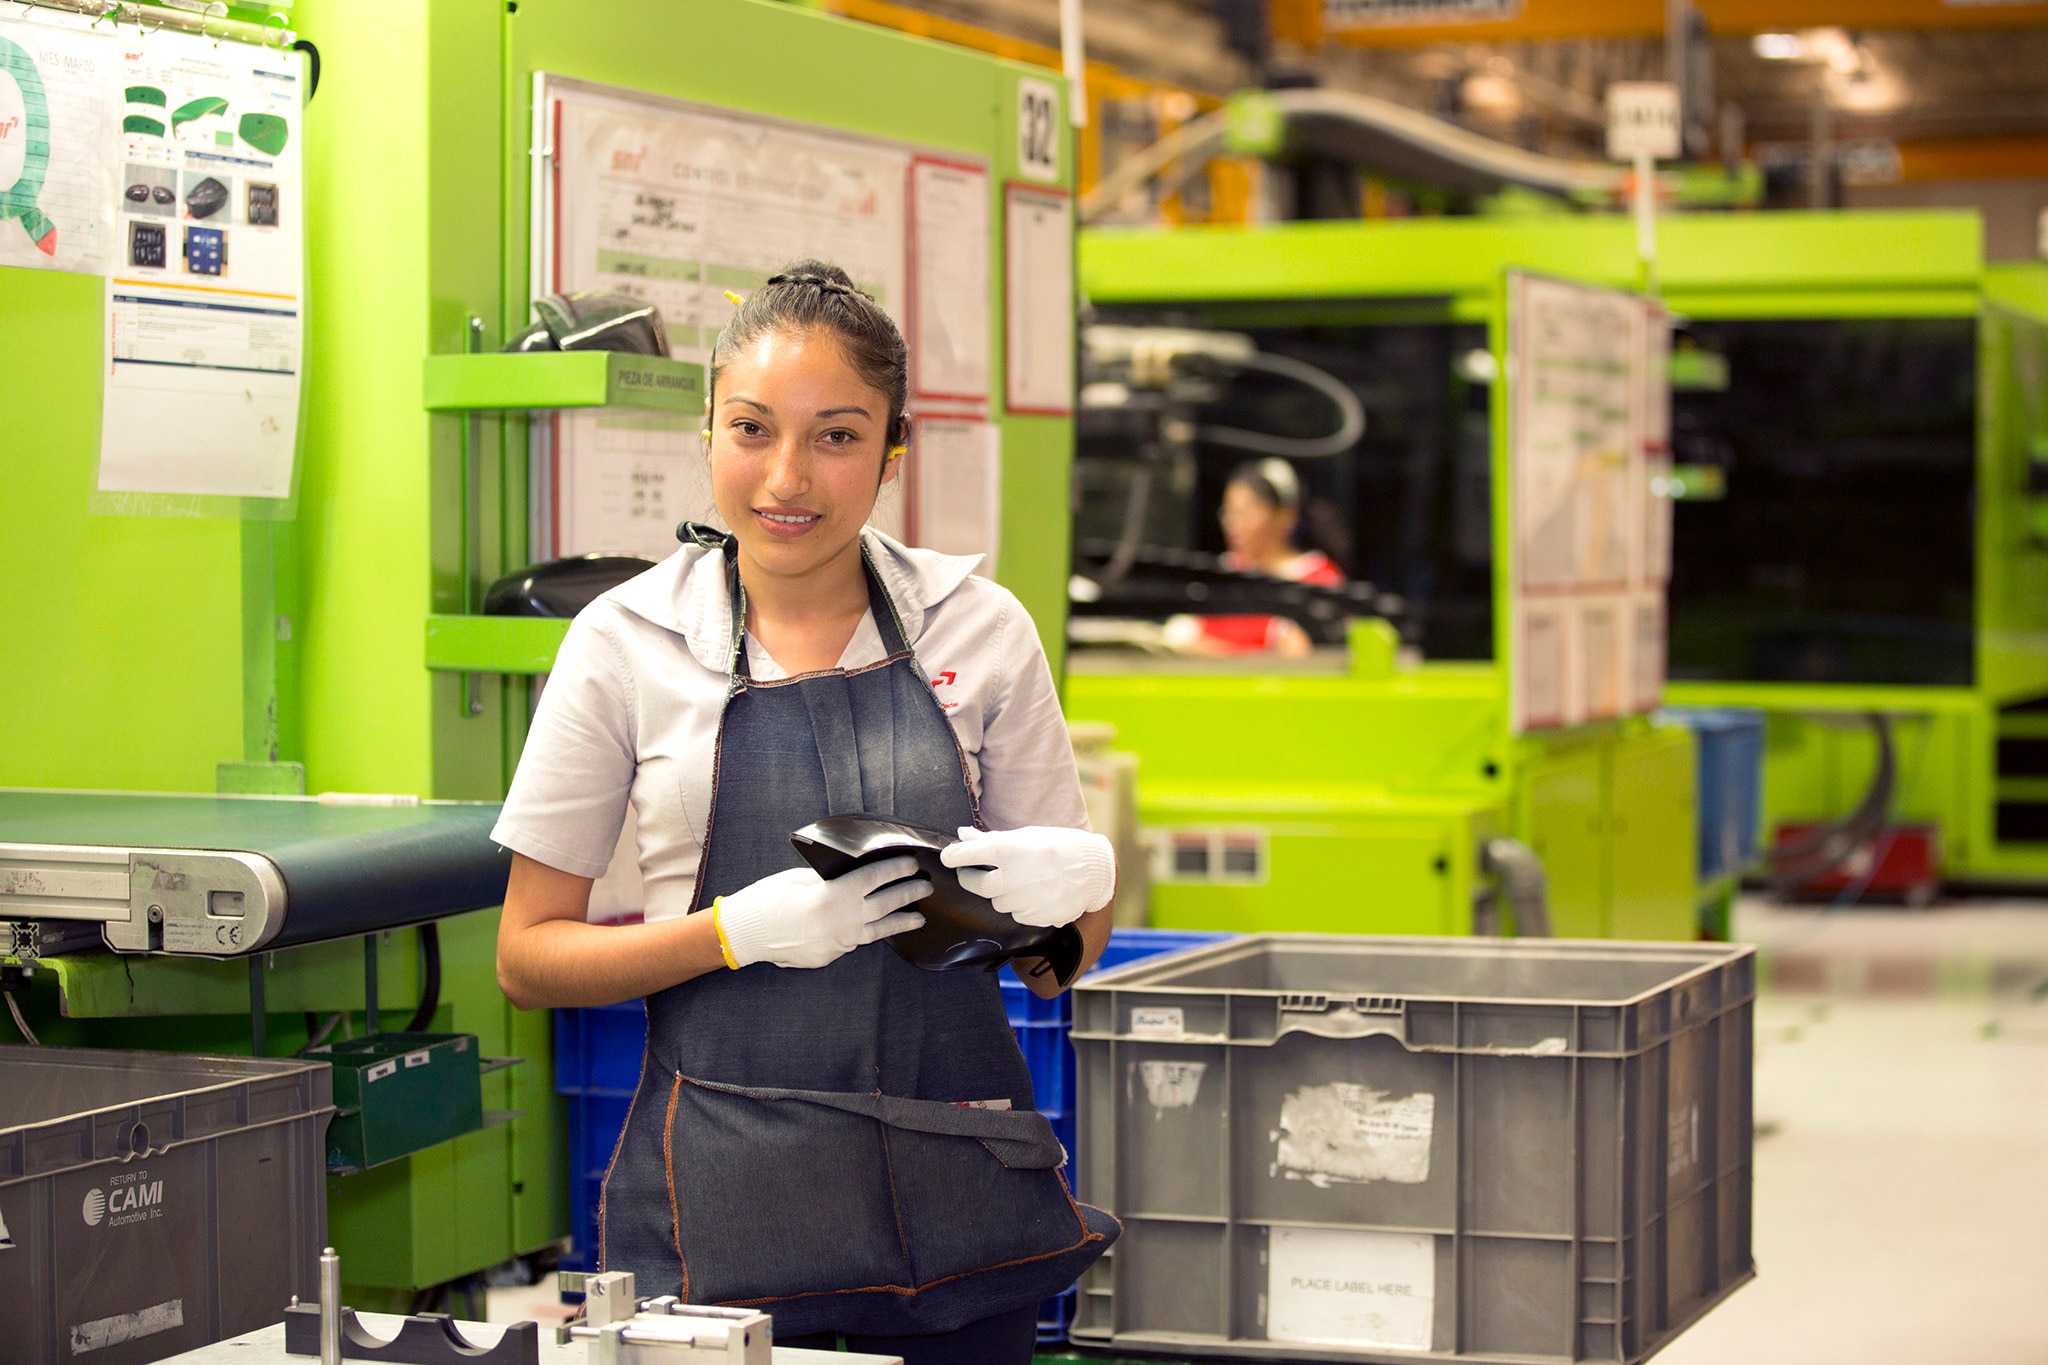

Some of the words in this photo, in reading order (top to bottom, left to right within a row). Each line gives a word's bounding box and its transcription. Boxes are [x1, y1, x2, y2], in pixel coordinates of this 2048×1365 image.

[39, 50, 60, 66] MES
[1022, 92, 1054, 165] 32
[110, 1173, 137, 1187] RETURN
[139, 1170, 148, 1181] TO
[109, 1180, 163, 1213] CAMI
[108, 1211, 148, 1228] Automotive
[150, 1208, 164, 1219] Inc.
[1289, 1276, 1332, 1292] PLACE
[1334, 1279, 1375, 1295] LABEL
[1377, 1282, 1413, 1298] HERE
